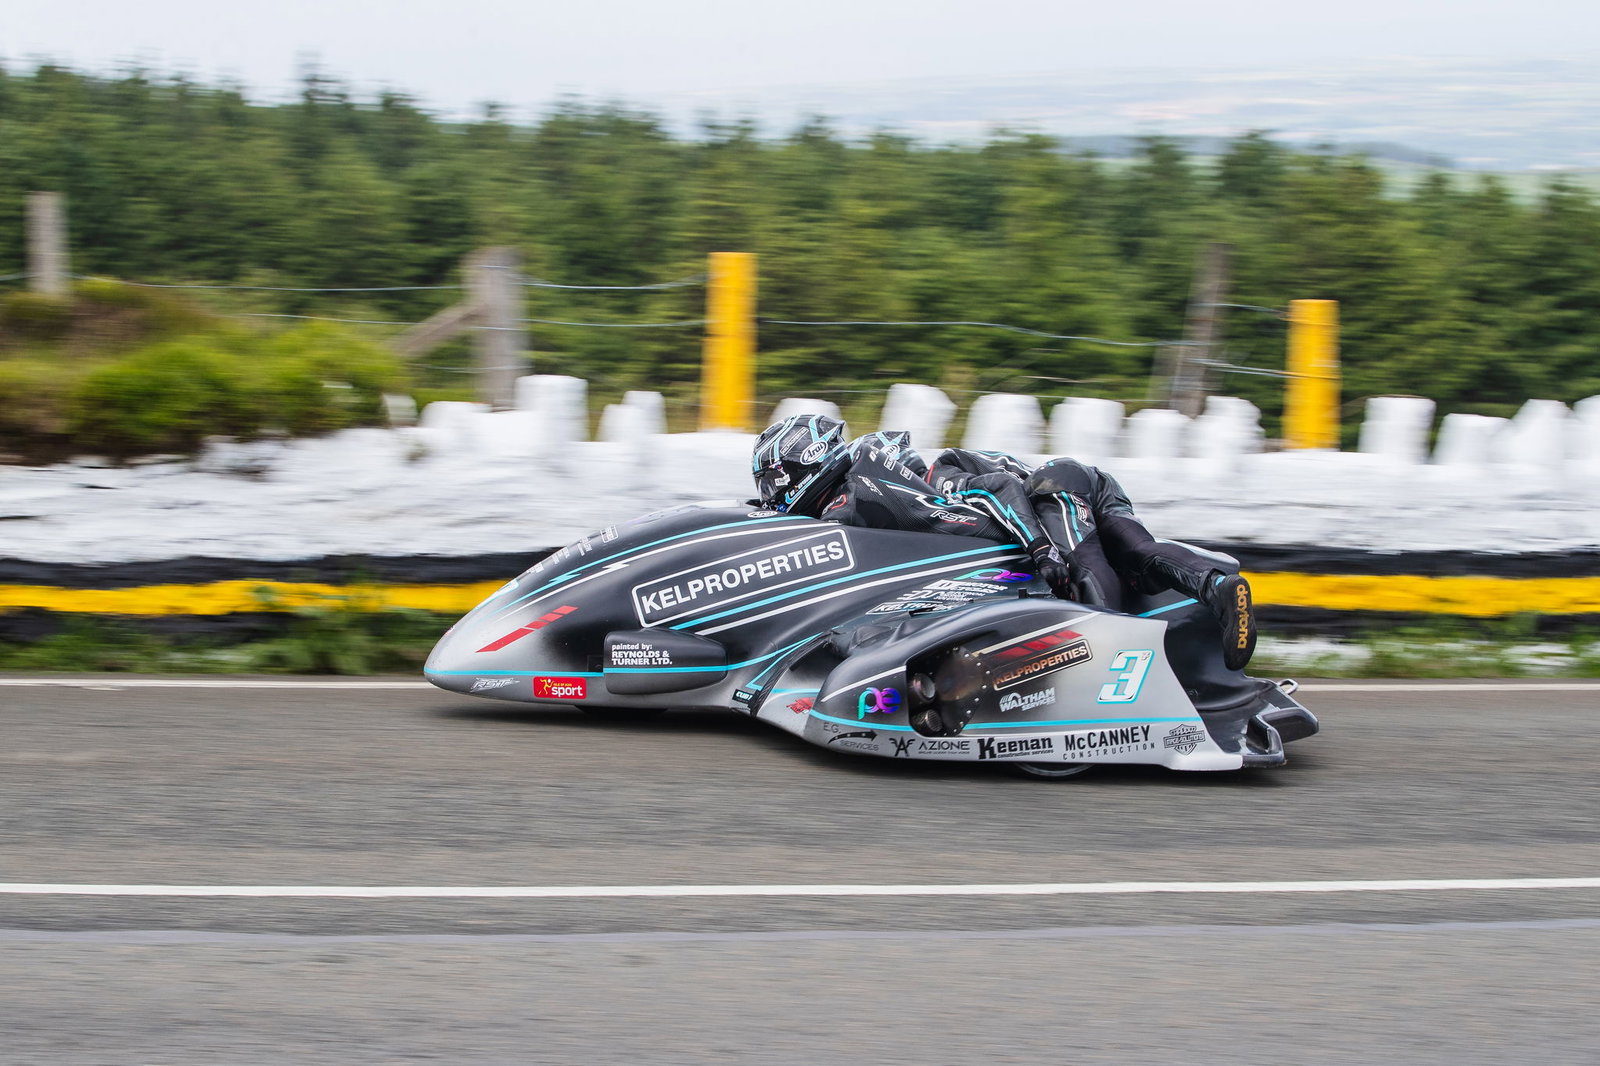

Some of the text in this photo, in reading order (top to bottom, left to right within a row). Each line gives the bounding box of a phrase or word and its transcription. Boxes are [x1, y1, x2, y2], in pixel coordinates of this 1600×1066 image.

[805, 443, 824, 462] Arai
[930, 510, 977, 522] RST
[641, 541, 845, 614] KELPROPERTIES
[1236, 584, 1249, 649] daytona
[612, 643, 653, 651] painted by:
[662, 650, 670, 658] &
[996, 645, 1088, 684] KELPROPERTIES
[1097, 649, 1155, 704] 3
[551, 685, 583, 697] sport
[1000, 687, 1055, 712] WALTHAM
[840, 739, 880, 751] SERVICES
[918, 740, 970, 750] AZIONE
[1065, 725, 1150, 751] McCANNEY
[977, 737, 1053, 760] Keenan
[998, 750, 1031, 758] construction
[1063, 742, 1155, 760] CONSTRUCTION
